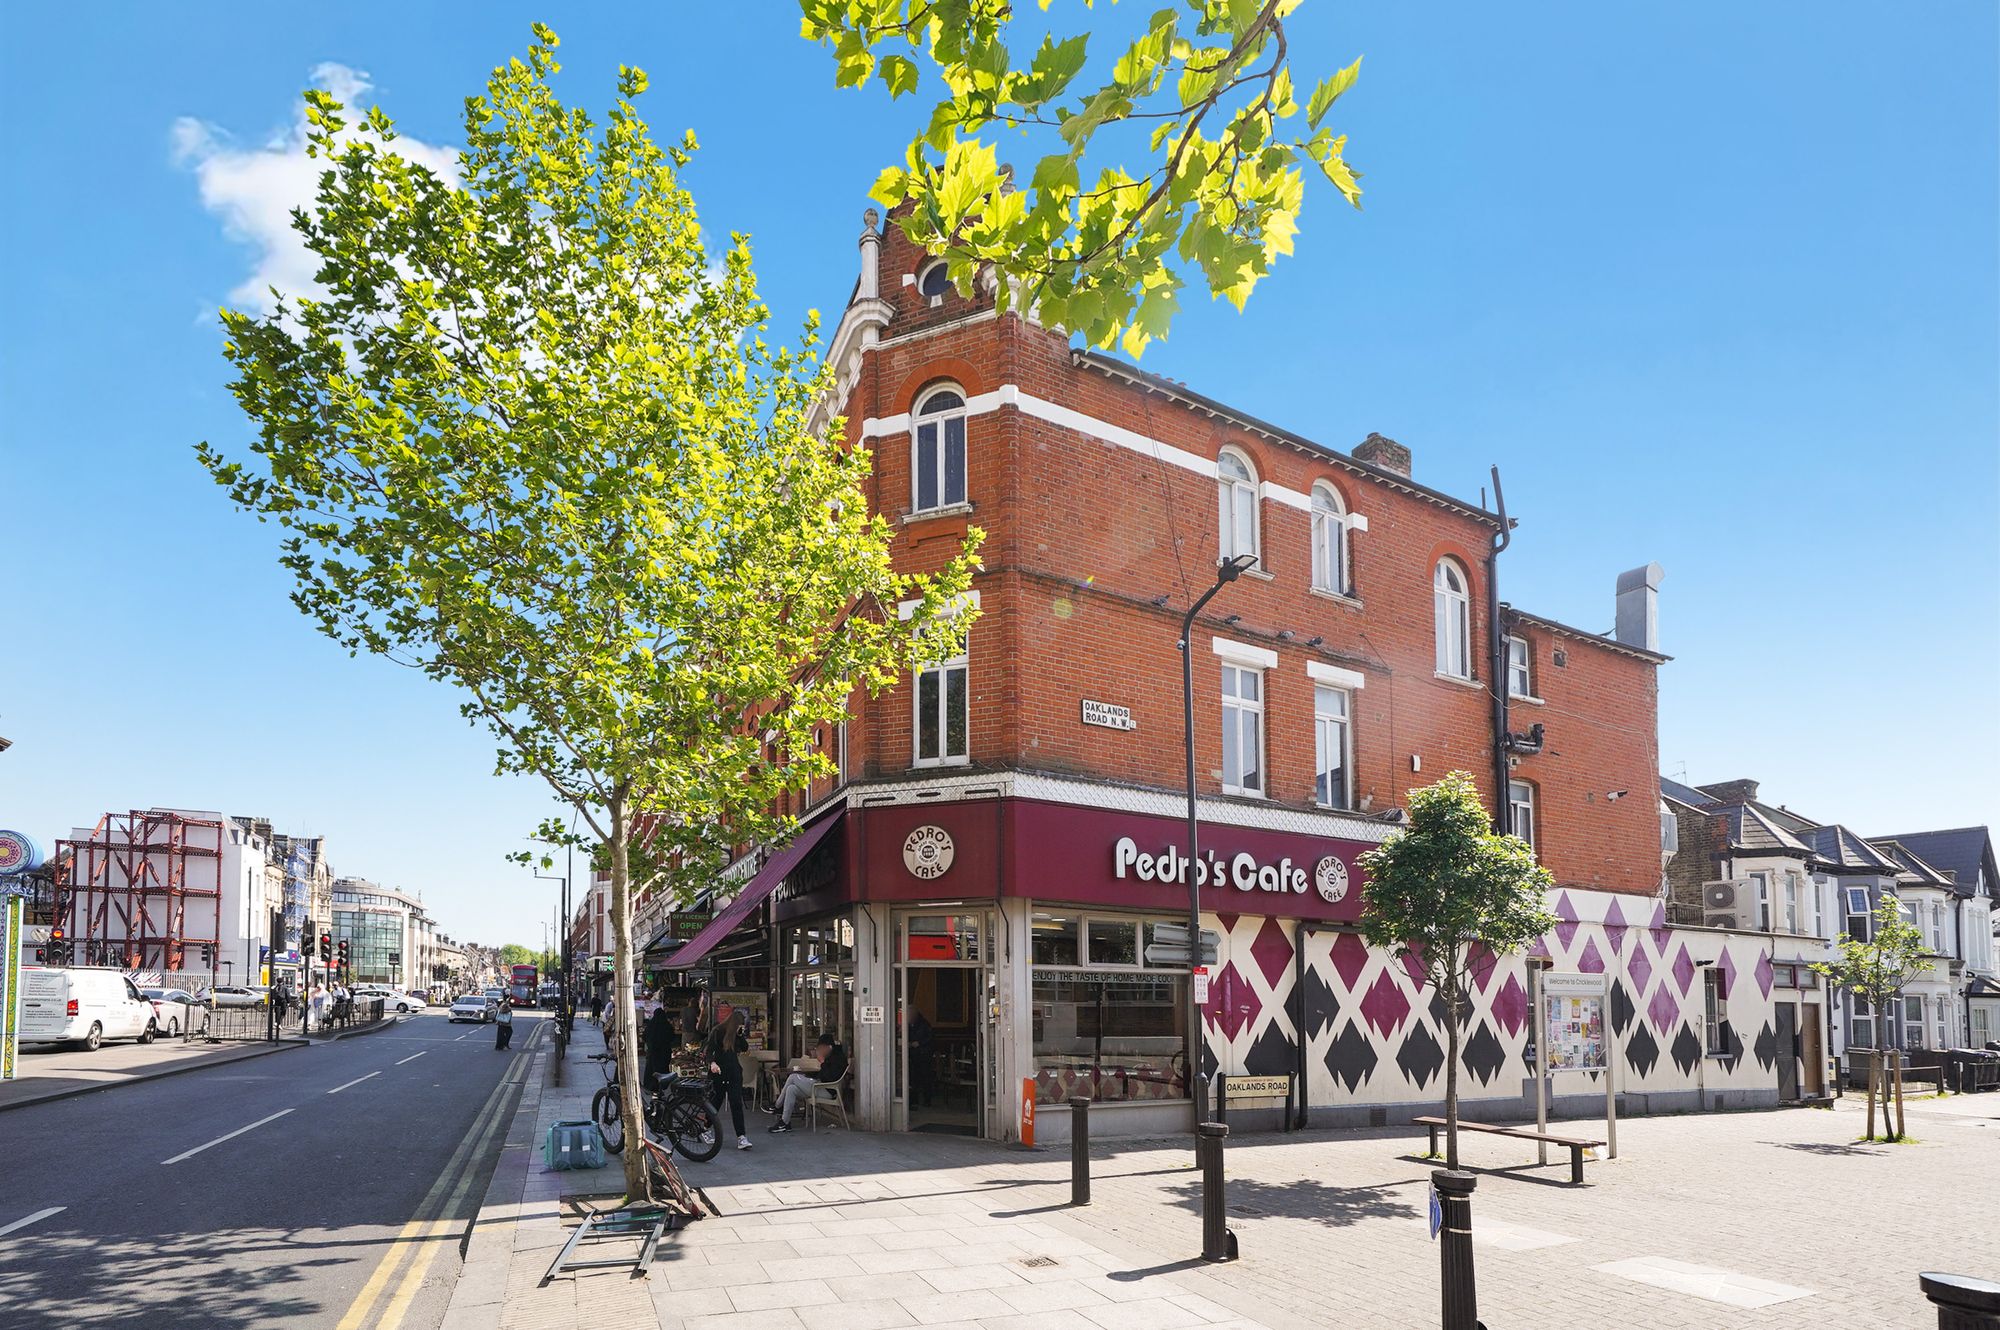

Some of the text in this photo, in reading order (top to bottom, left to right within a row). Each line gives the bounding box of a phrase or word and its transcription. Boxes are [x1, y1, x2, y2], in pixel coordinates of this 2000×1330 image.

[1085, 702, 1128, 717] OAKLANDS
[1086, 713, 1107, 723] ROAD
[905, 827, 951, 852] PEDRO'S
[1116, 837, 1226, 887] Pedro's
[1232, 852, 1308, 894] Cafe
[1318, 858, 1347, 880] PEDRO'S
[1032, 971, 1057, 981] ENJOY
[1059, 972, 1073, 981] THE
[1075, 972, 1099, 981] TASTE
[1101, 973, 1111, 982] OF
[1114, 973, 1134, 983] HOME
[1136, 974, 1156, 983] MADE
[1226, 1082, 1288, 1092] OAKLANDS ROAD
